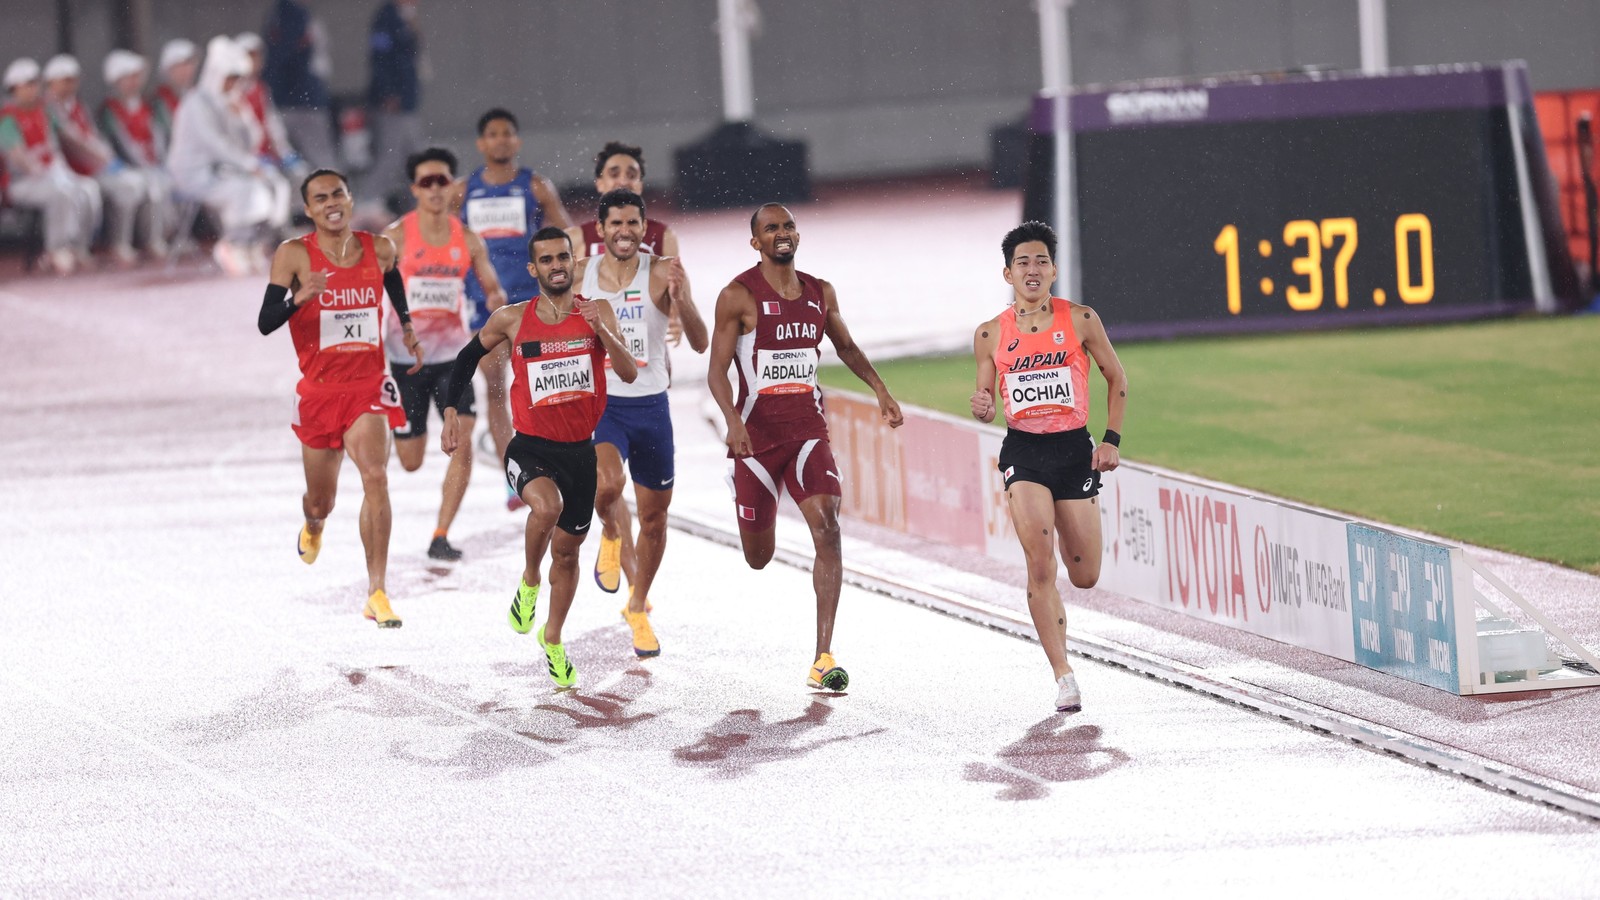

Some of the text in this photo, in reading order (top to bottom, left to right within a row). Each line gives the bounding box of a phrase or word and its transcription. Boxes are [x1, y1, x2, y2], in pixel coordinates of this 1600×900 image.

[1214, 213, 1435, 315] 1:37.0
[318, 286, 376, 307] CHINA
[334, 312, 369, 320] BORNAN
[616, 305, 644, 320] AIT
[344, 324, 361, 338] XI
[776, 322, 817, 340] QATAR
[541, 358, 579, 371] BORNAN
[772, 351, 807, 360] BORNAN
[1009, 350, 1067, 372] JAPAN
[535, 369, 590, 392] AMIRIAN
[762, 363, 814, 380] ABDALLA
[1018, 371, 1059, 382] BORNAN
[1012, 382, 1070, 403] OCHIAI
[1159, 487, 1249, 622] TOYOTA
[1270, 542, 1301, 609] MUFG
[1305, 559, 1347, 613] MUFG Bank
[1359, 617, 1381, 654] NITORI
[1393, 627, 1416, 664] NITORI
[1428, 637, 1451, 674] NITORI
